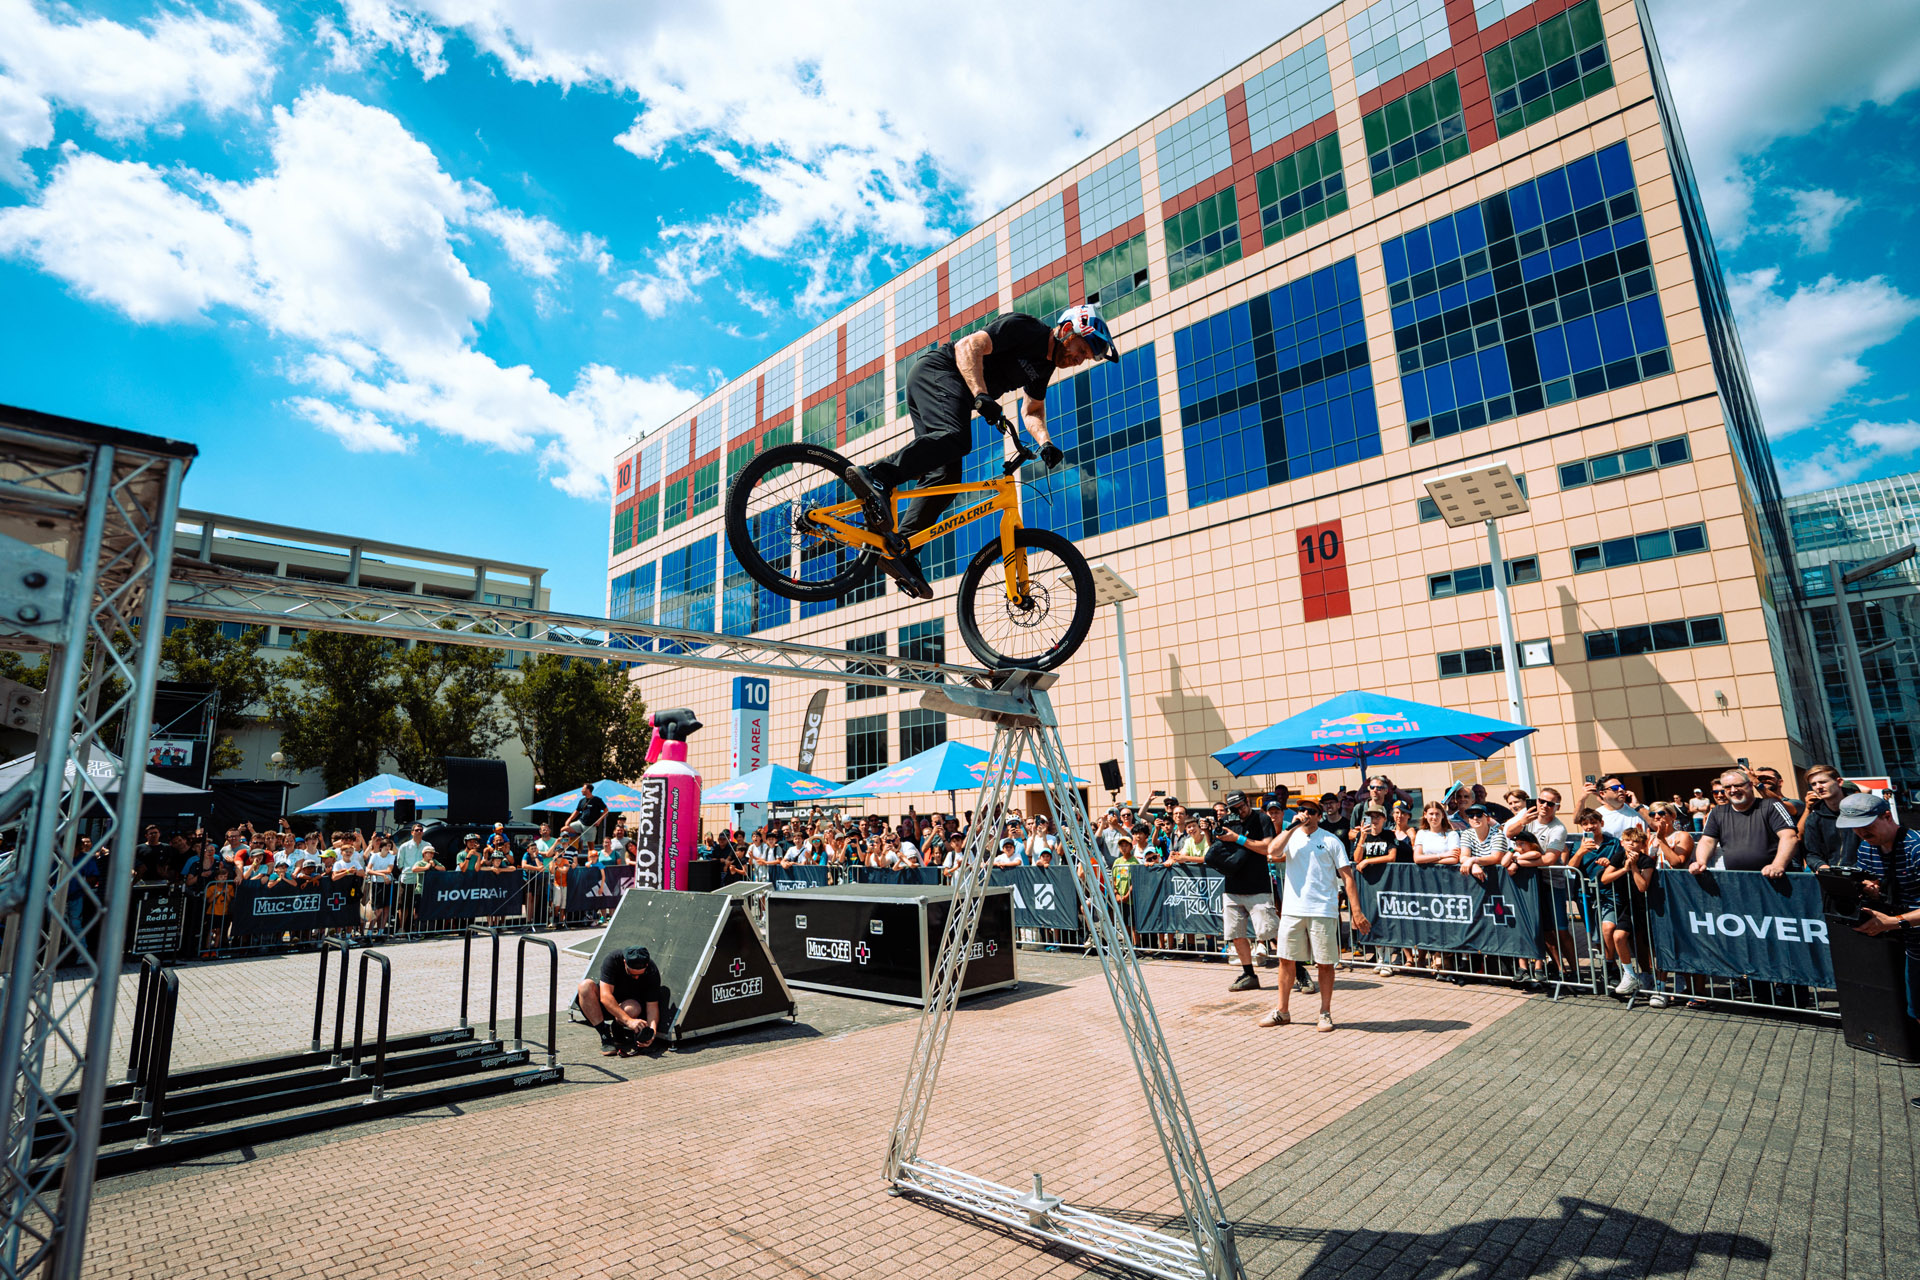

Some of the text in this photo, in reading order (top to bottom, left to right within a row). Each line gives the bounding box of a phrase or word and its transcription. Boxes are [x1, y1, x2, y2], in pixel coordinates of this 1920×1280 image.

[618, 464, 631, 489] 10
[929, 501, 994, 538] SANTA CRUZ
[1301, 530, 1339, 564] 10
[745, 682, 767, 705] 10
[751, 718, 761, 754] AREA
[803, 713, 822, 750] TSG
[1311, 721, 1420, 740] Red Bull
[1212, 780, 1219, 790] 5
[671, 787, 680, 810] spray
[671, 823, 680, 843] wash
[670, 859, 676, 869] no
[437, 887, 508, 902] HOVERAir
[1171, 876, 1226, 897] DROP
[256, 896, 318, 913] Muc-Off
[1182, 896, 1224, 919] ROLL
[1381, 896, 1468, 920] Muc-Off
[808, 941, 849, 959] Muc-Off
[714, 979, 760, 1000] Muc-Off
